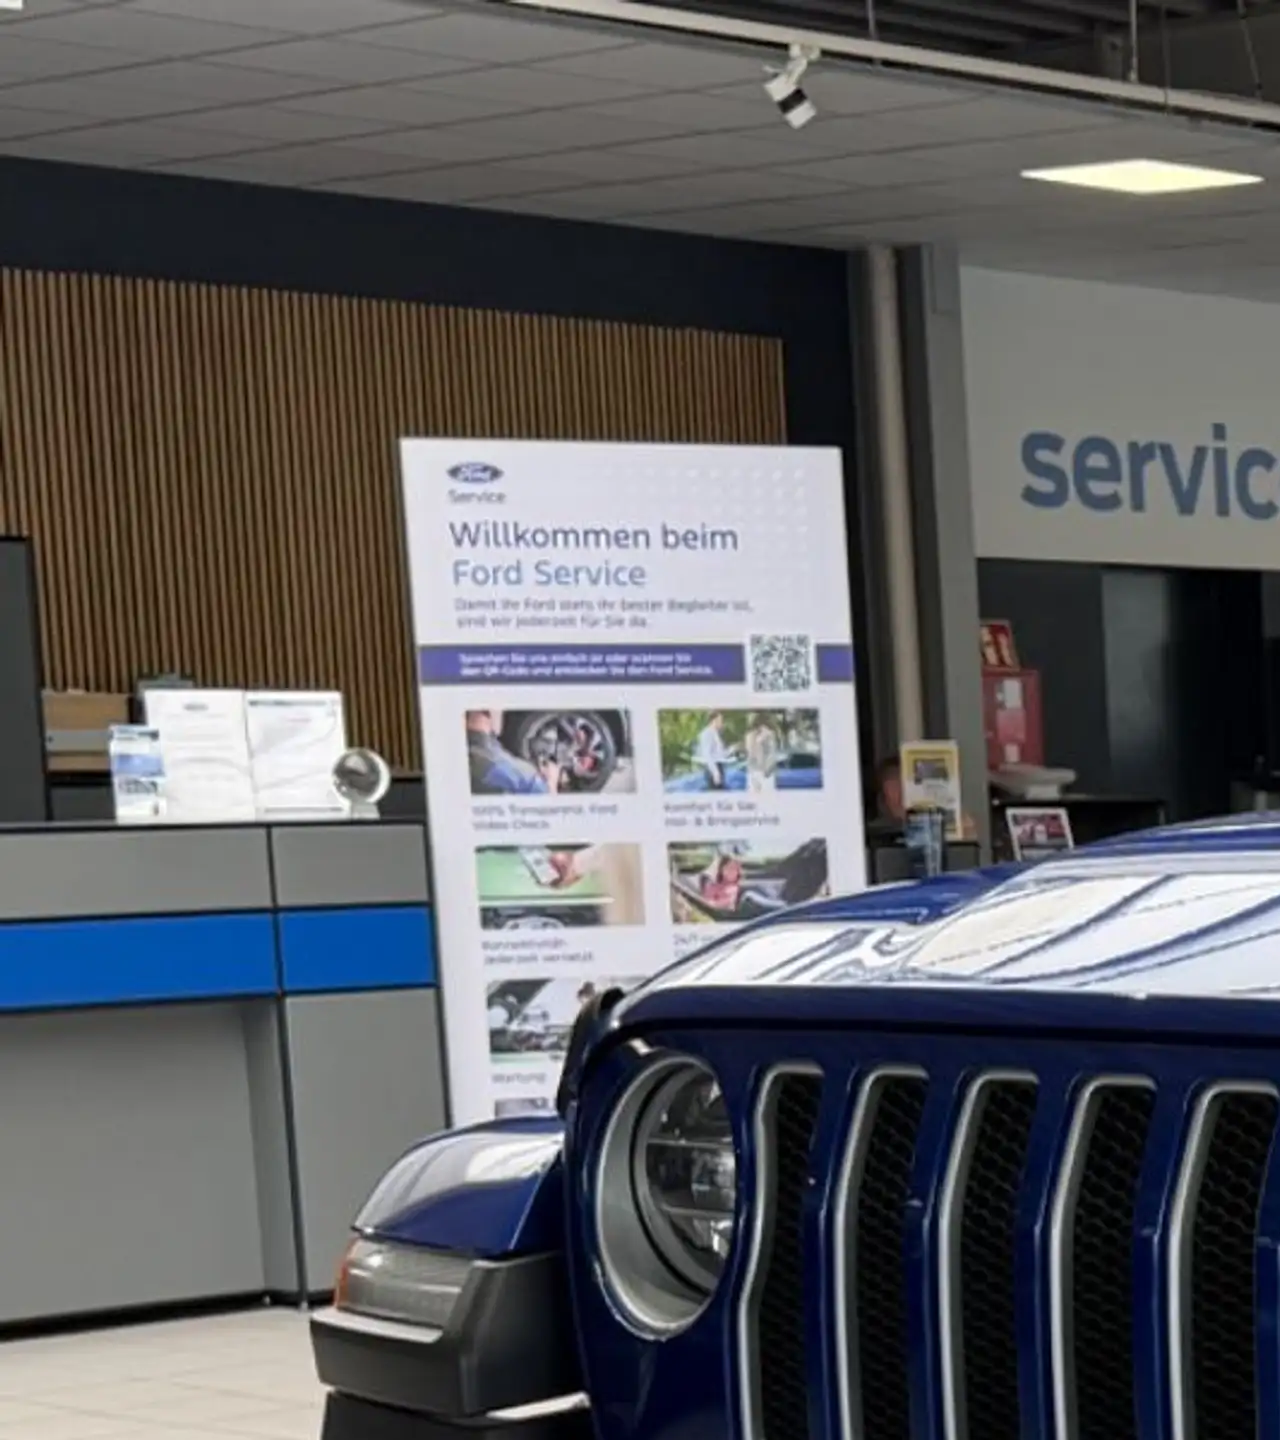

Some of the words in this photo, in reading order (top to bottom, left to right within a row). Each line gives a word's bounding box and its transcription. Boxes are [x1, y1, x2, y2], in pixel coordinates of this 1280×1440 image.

[448, 489, 506, 504] Service
[449, 519, 651, 550] Willkommen
[661, 521, 739, 551] beim
[452, 559, 523, 586] Ford
[534, 559, 647, 587] Service
